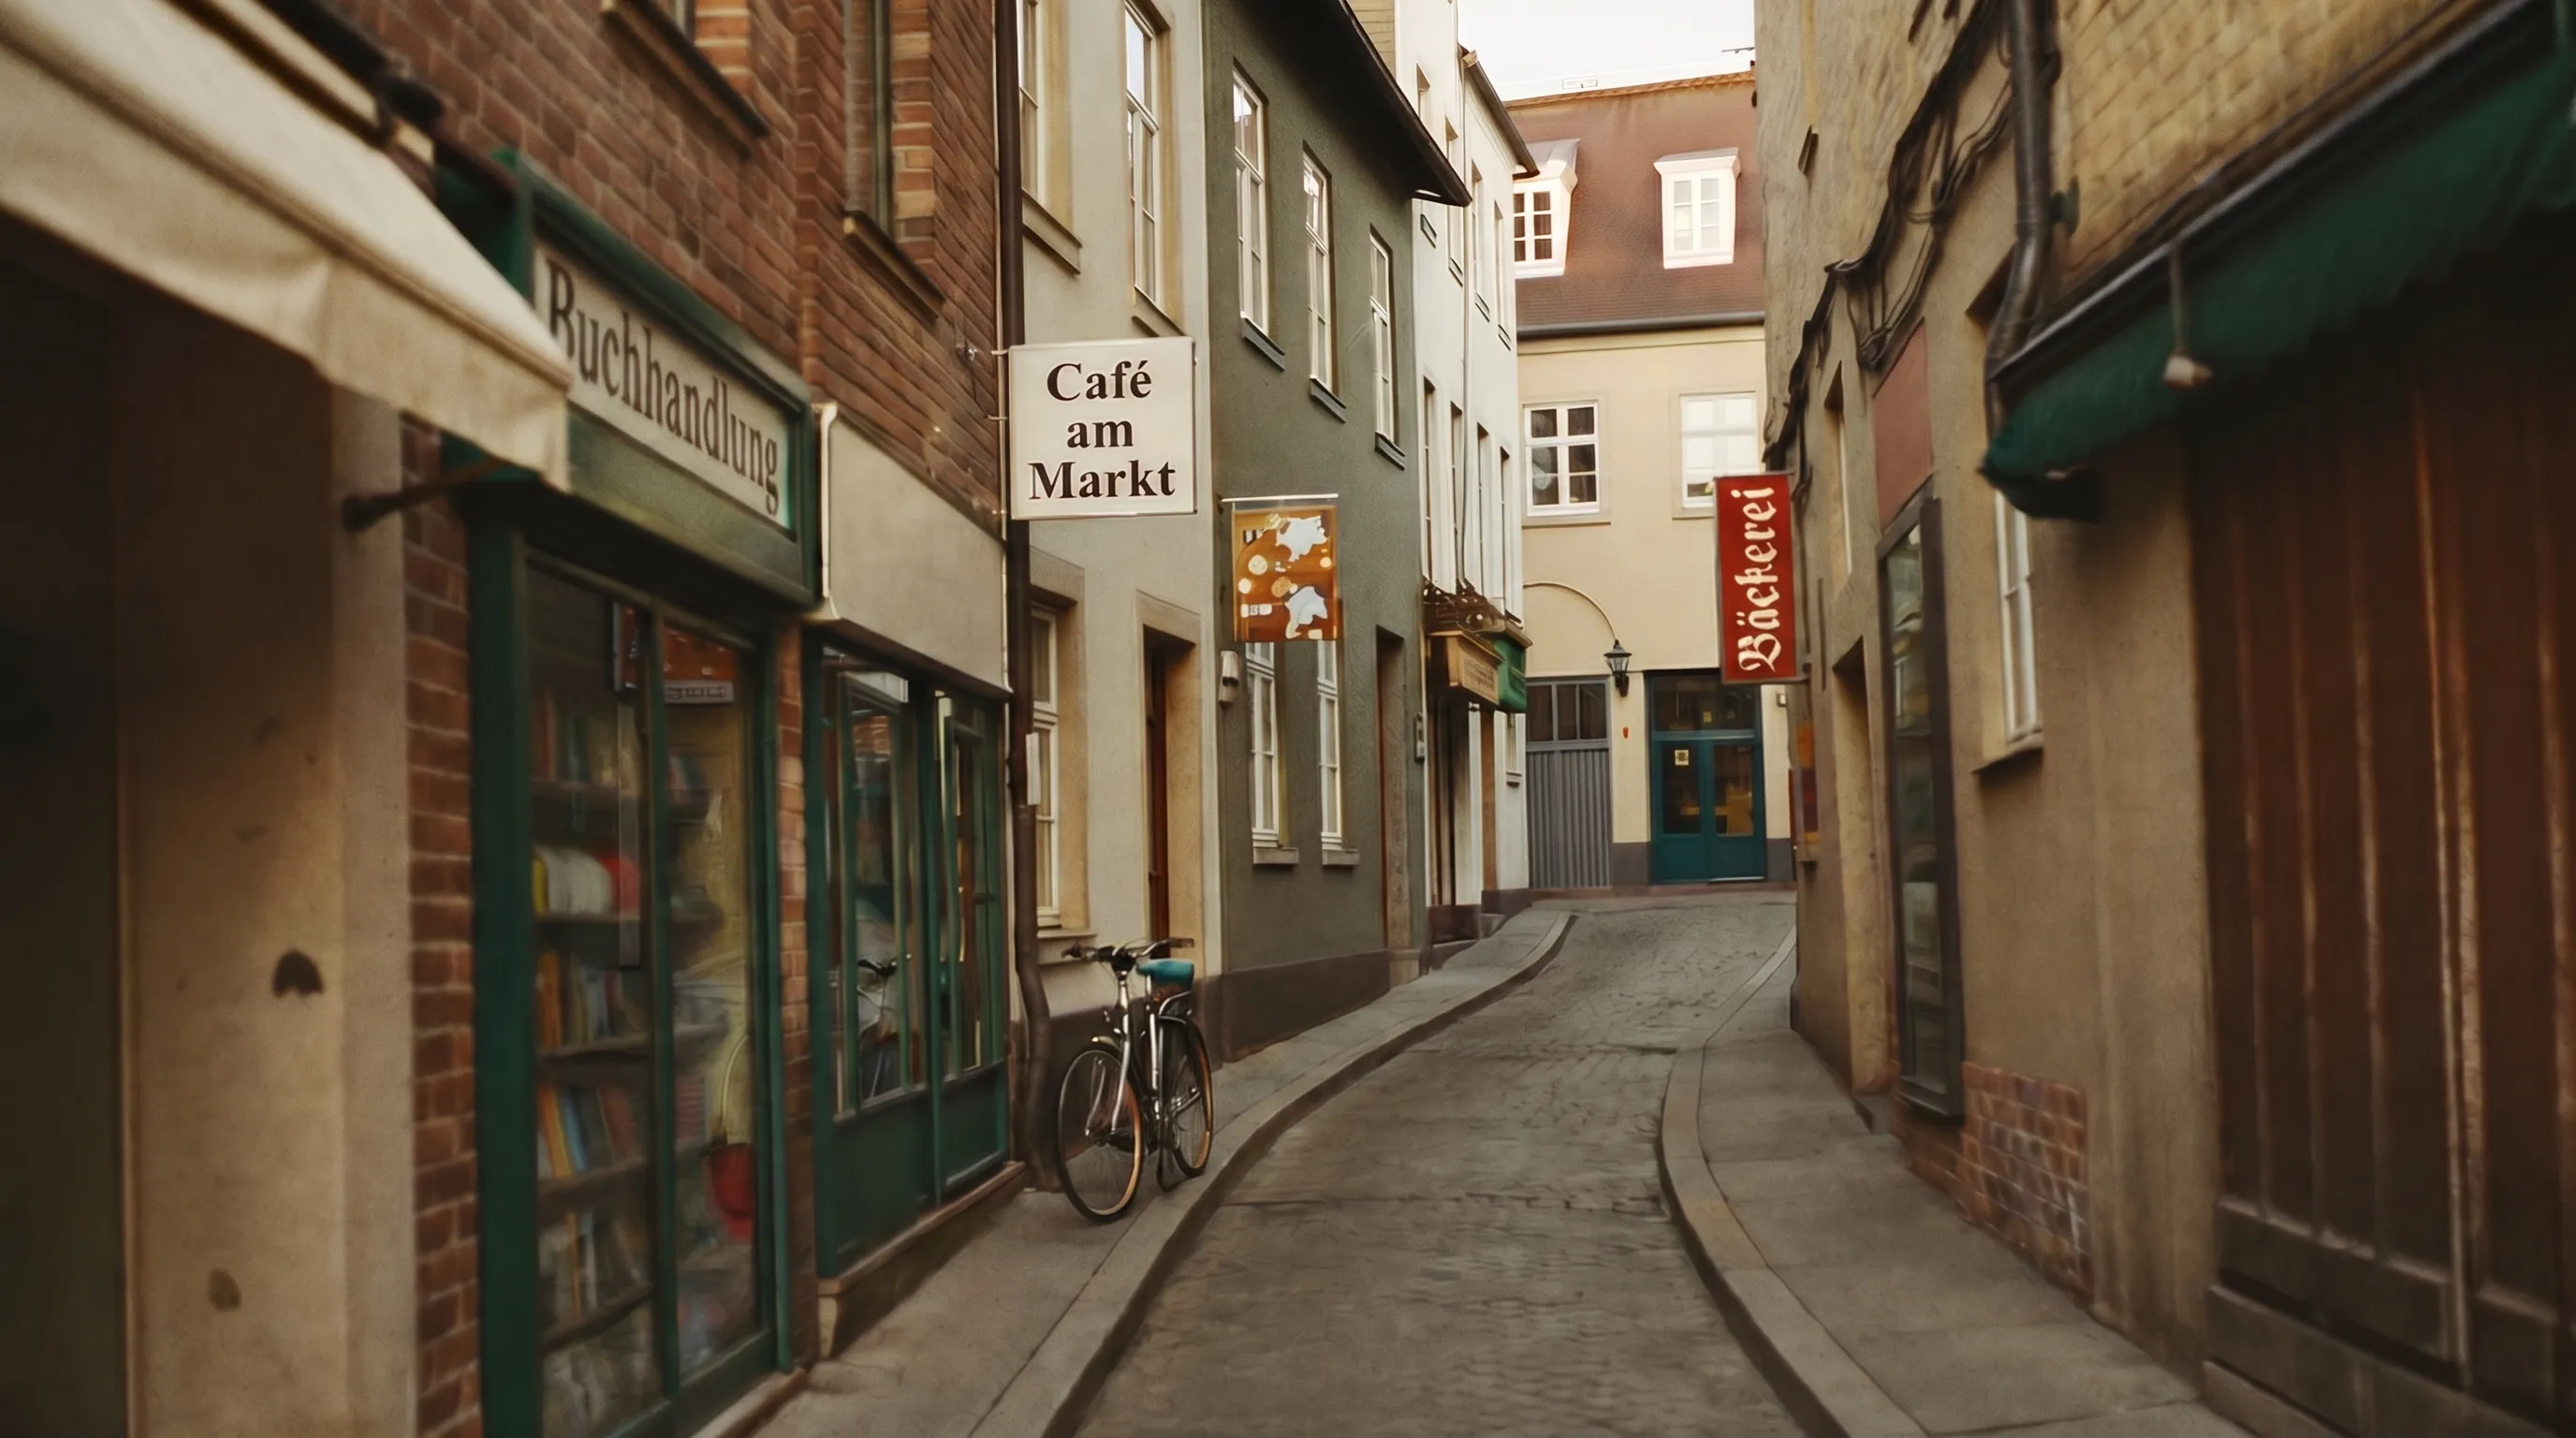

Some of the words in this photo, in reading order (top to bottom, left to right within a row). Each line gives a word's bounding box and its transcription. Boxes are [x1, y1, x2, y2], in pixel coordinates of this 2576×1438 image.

[546, 256, 779, 517] Buchhandlung
[1046, 360, 1153, 402] Café
[1066, 418, 1134, 448] am
[1028, 459, 1177, 501] Markt
[1730, 487, 1782, 673] Bäckerei
